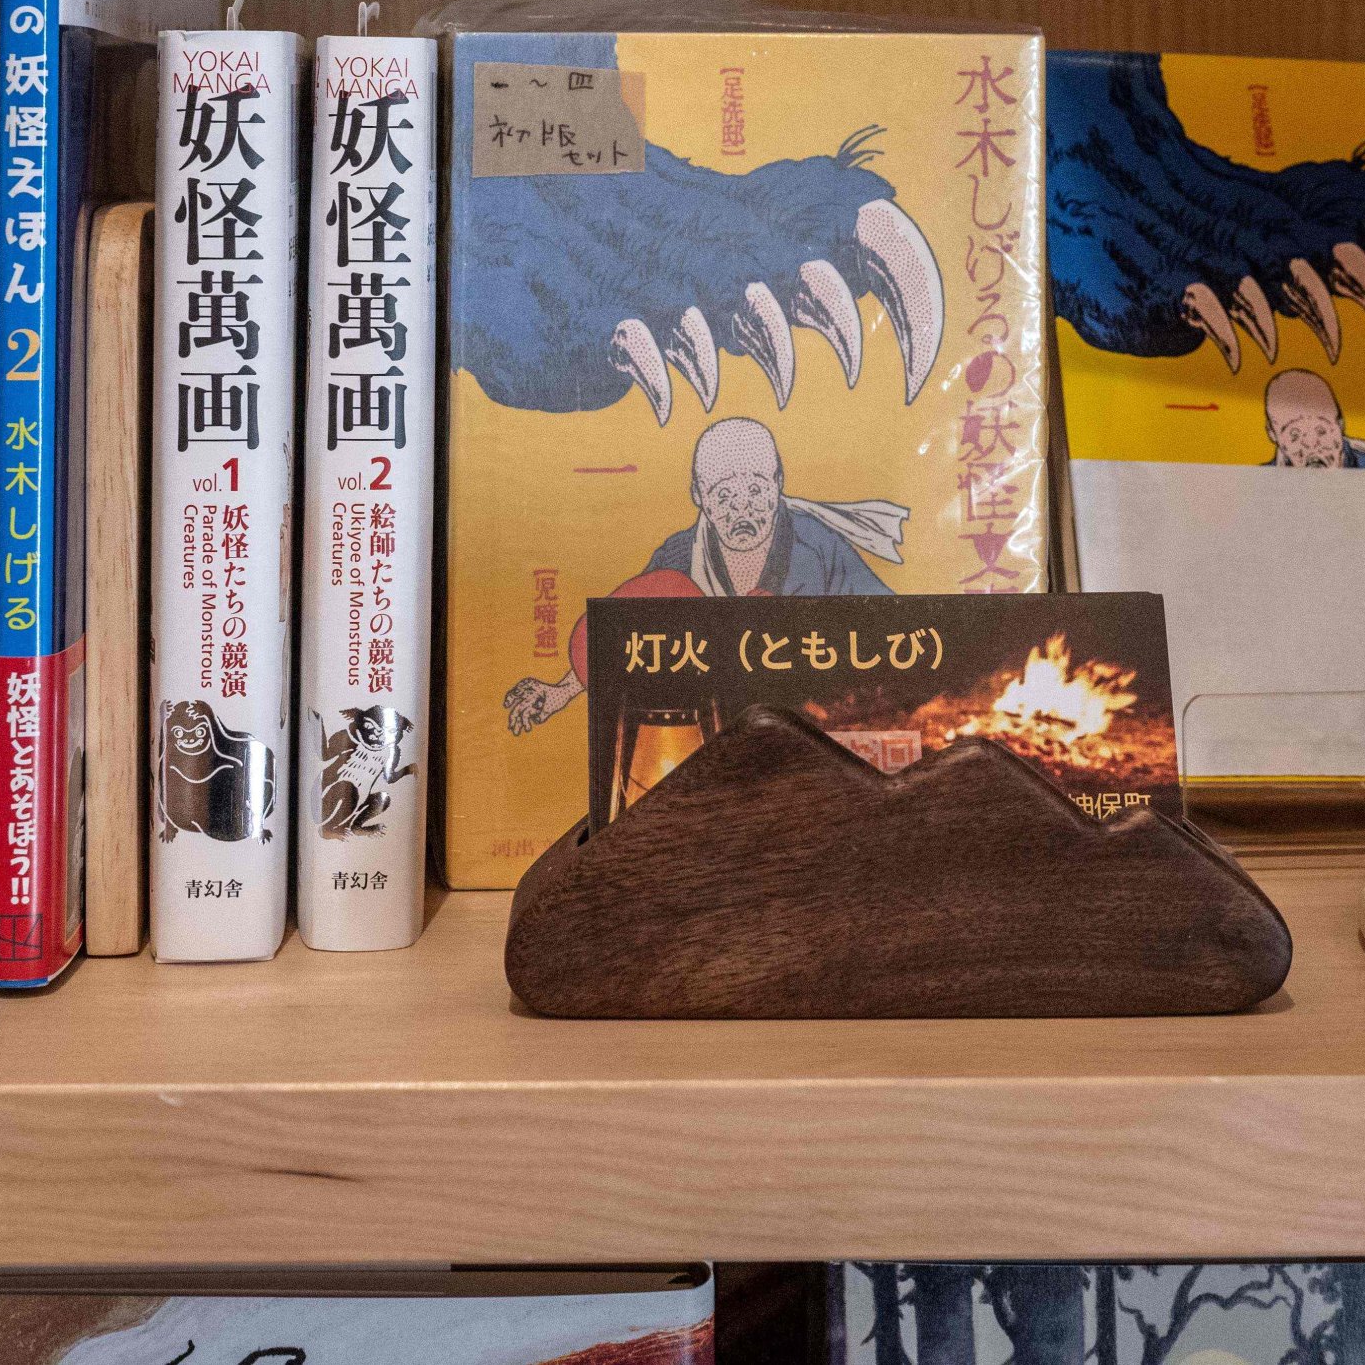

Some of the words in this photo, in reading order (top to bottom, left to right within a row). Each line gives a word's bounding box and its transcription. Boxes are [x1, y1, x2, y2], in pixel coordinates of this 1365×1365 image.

[173, 73, 272, 94] MANGA
[183, 50, 260, 72] YOKAI
[326, 78, 419, 100] MANGA
[335, 56, 409, 78] YOKAI
[174, 84, 266, 453] 妖怪萬画
[326, 89, 414, 452] 妖怪萬画
[955, 55, 1021, 593] 水木しげるの妖怪文
[4, 417, 39, 631] 水木しげる
[183, 504, 199, 589] Creatures
[202, 505, 218, 564] Parade
[331, 502, 347, 586] Creatures
[347, 503, 366, 564] Ukiyoe
[202, 568, 218, 588] of
[220, 503, 251, 699] 妖怪たちの競演
[349, 567, 365, 587] of
[367, 502, 398, 693] 絵師たちの競演
[200, 592, 217, 689] Monstrous
[348, 591, 364, 686] Monstrous
[184, 878, 243, 899] 青幻舎
[331, 870, 388, 891] 青幻舎
